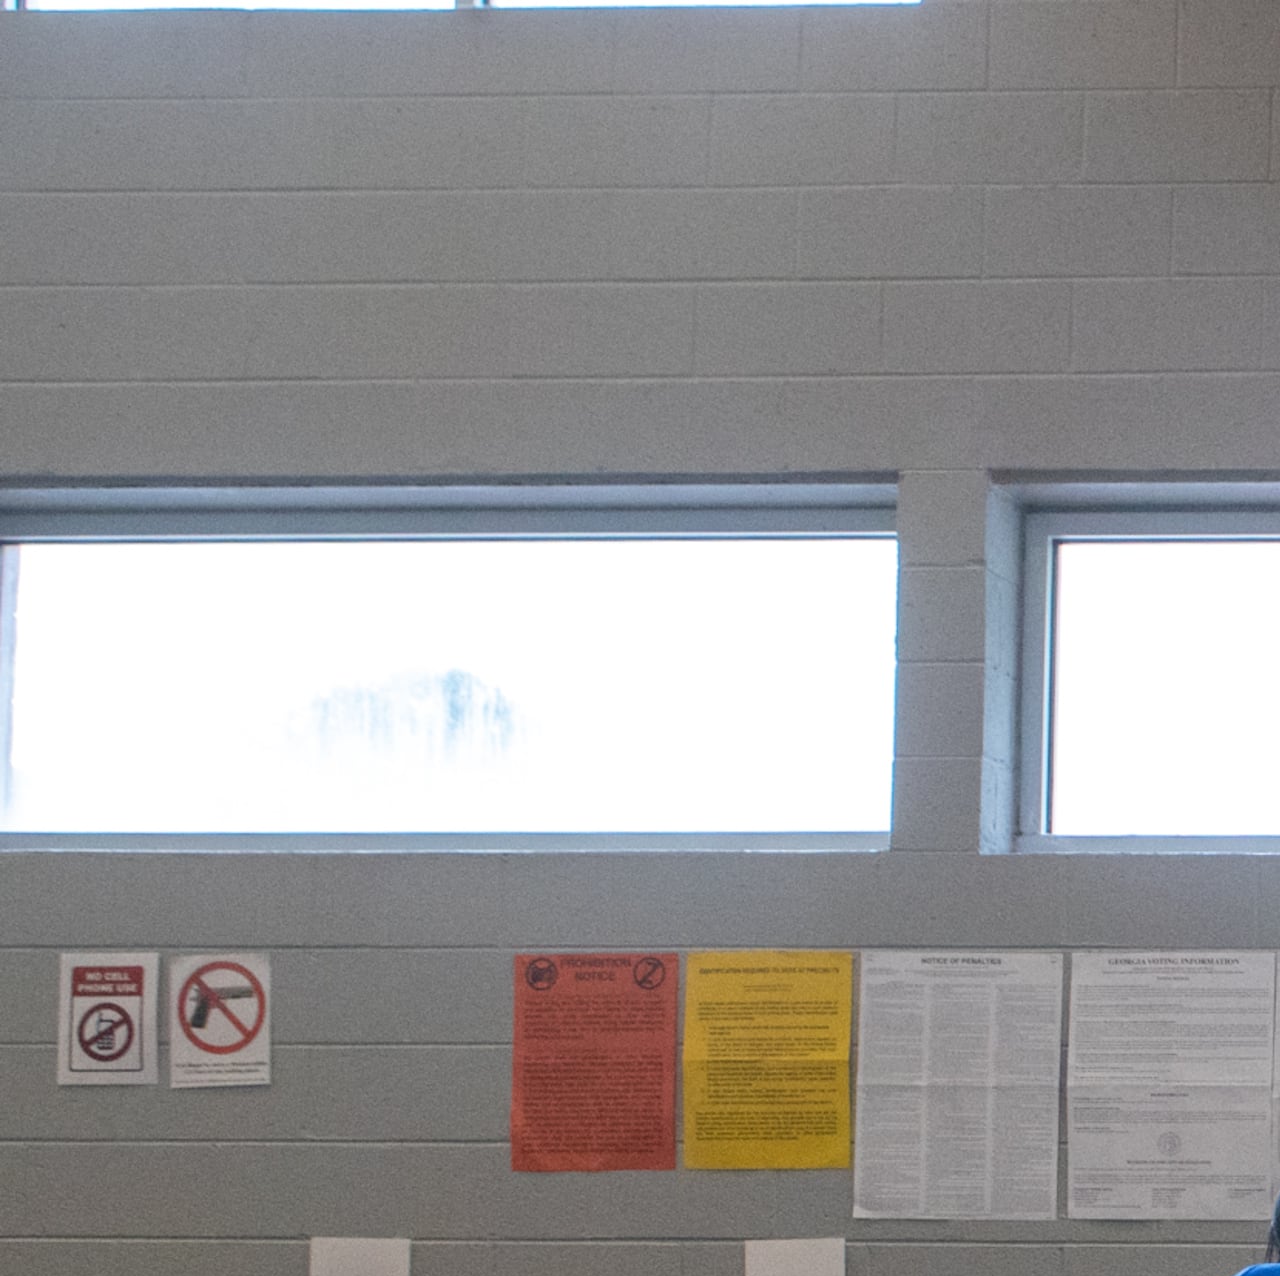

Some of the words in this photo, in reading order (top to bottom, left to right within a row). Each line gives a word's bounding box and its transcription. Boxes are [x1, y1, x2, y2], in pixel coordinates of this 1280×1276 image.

[560, 958, 631, 968] PROHIBITION
[1108, 958, 1146, 966] GEORGIA
[1148, 958, 1178, 966] VOTING
[1180, 958, 1240, 966] INFORMATION
[86, 973, 102, 981] NO
[104, 973, 130, 981] CELL
[575, 971, 615, 981] NOTICE
[78, 984, 114, 993] PHONE
[116, 984, 138, 992] USE
